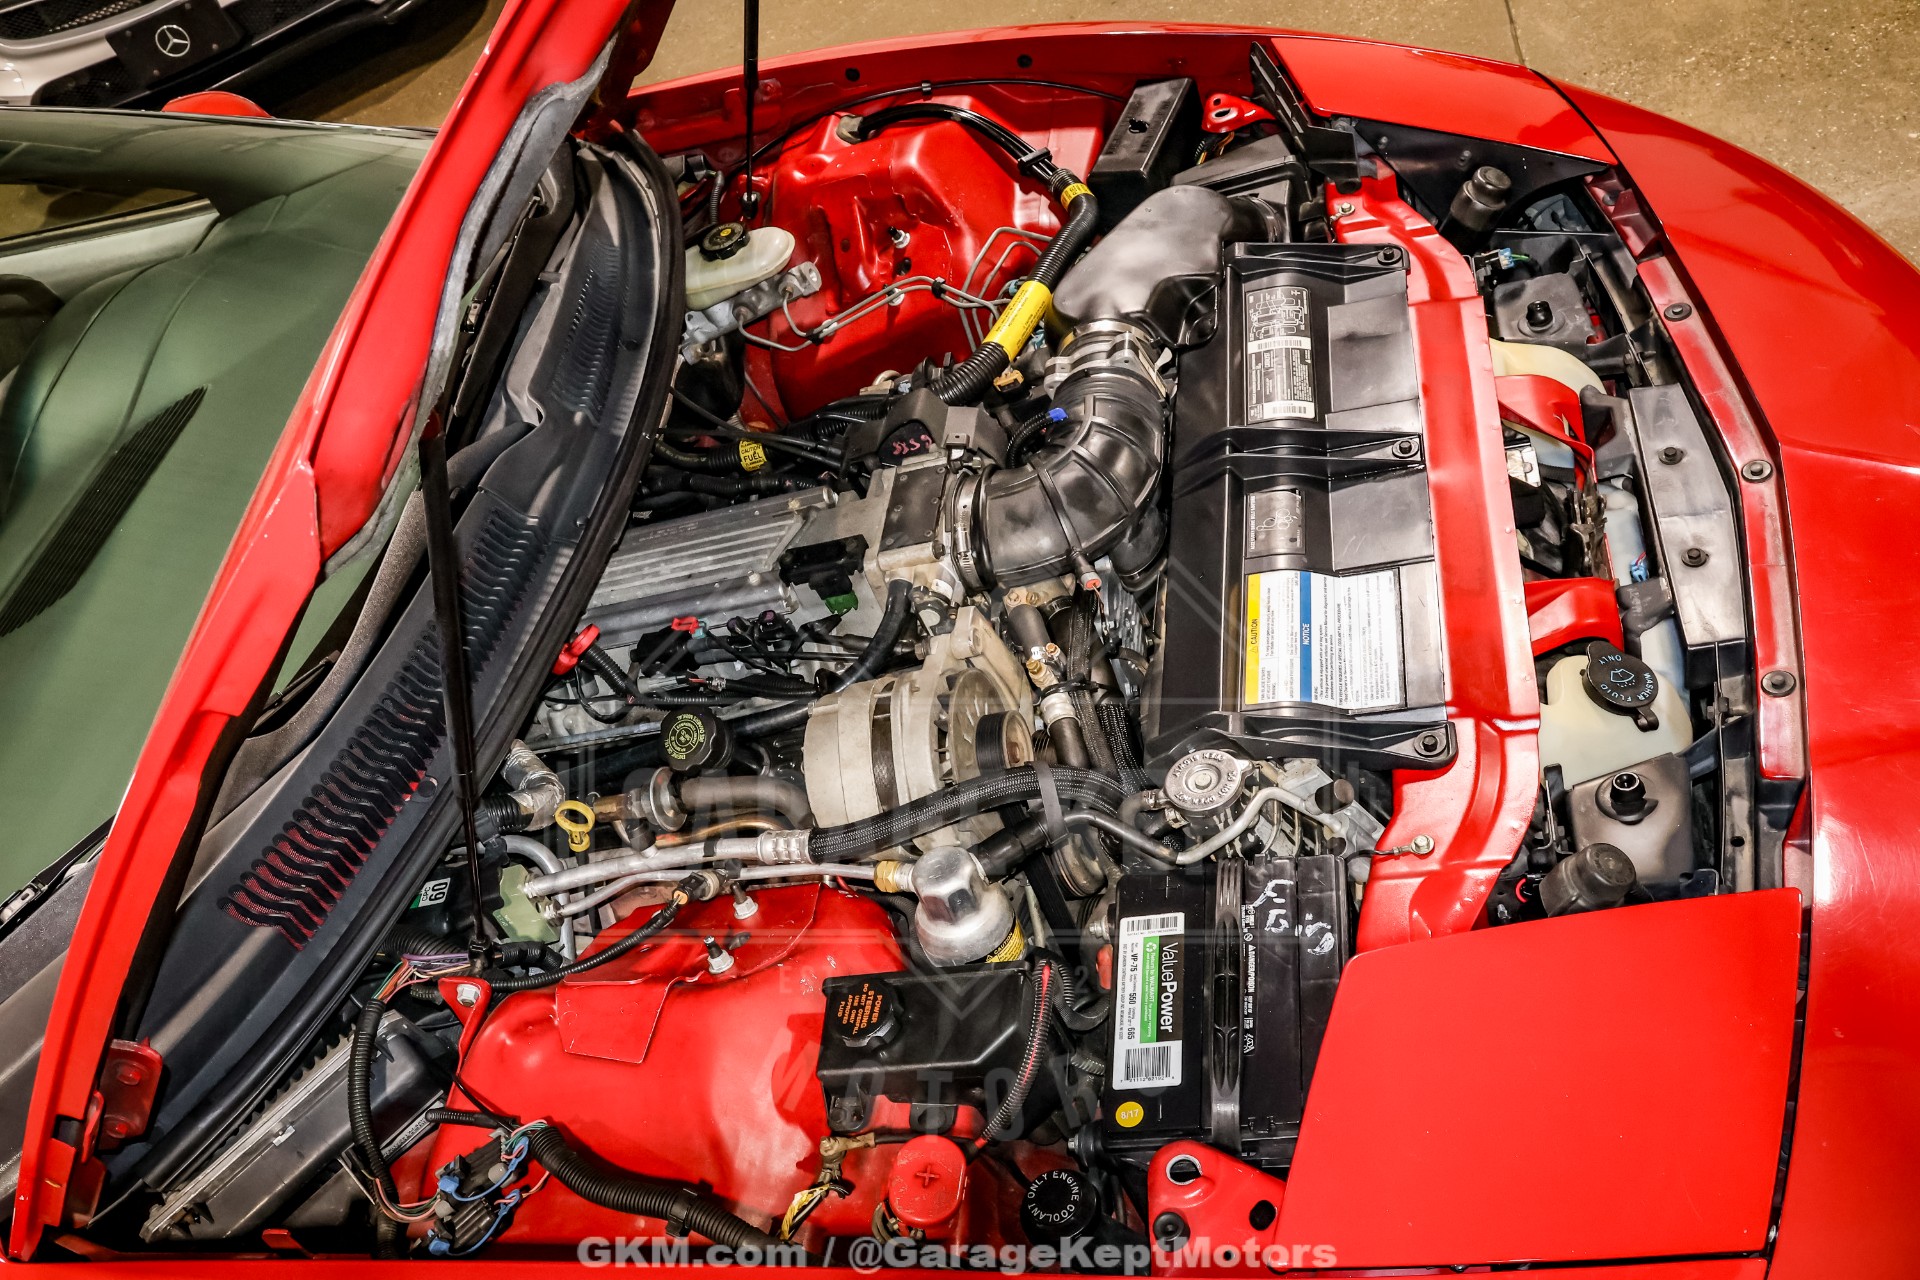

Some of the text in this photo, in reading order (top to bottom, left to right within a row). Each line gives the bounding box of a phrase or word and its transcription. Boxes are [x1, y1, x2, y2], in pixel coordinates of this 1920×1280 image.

[741, 445, 762, 454] CAUTION
[743, 453, 762, 463] FUEL
[1250, 618, 1258, 645] CAUTION
[1599, 654, 1654, 702] WASHER FLUID ONLY
[429, 882, 448, 901] 60
[994, 932, 1013, 954] CAUTION
[1130, 953, 1138, 972] VP-75
[863, 983, 869, 992] DO
[1160, 942, 1178, 1032] ValuePower
[837, 1001, 845, 1017] FLUID
[842, 994, 853, 1024] APPROVED
[861, 990, 875, 1028] STEERING
[871, 995, 883, 1023] POWER
[852, 1009, 863, 1035] OVERFILL
[1121, 1109, 1139, 1120] 8/17
[1027, 1171, 1080, 1222] ENGINE COOLANT ONLY
